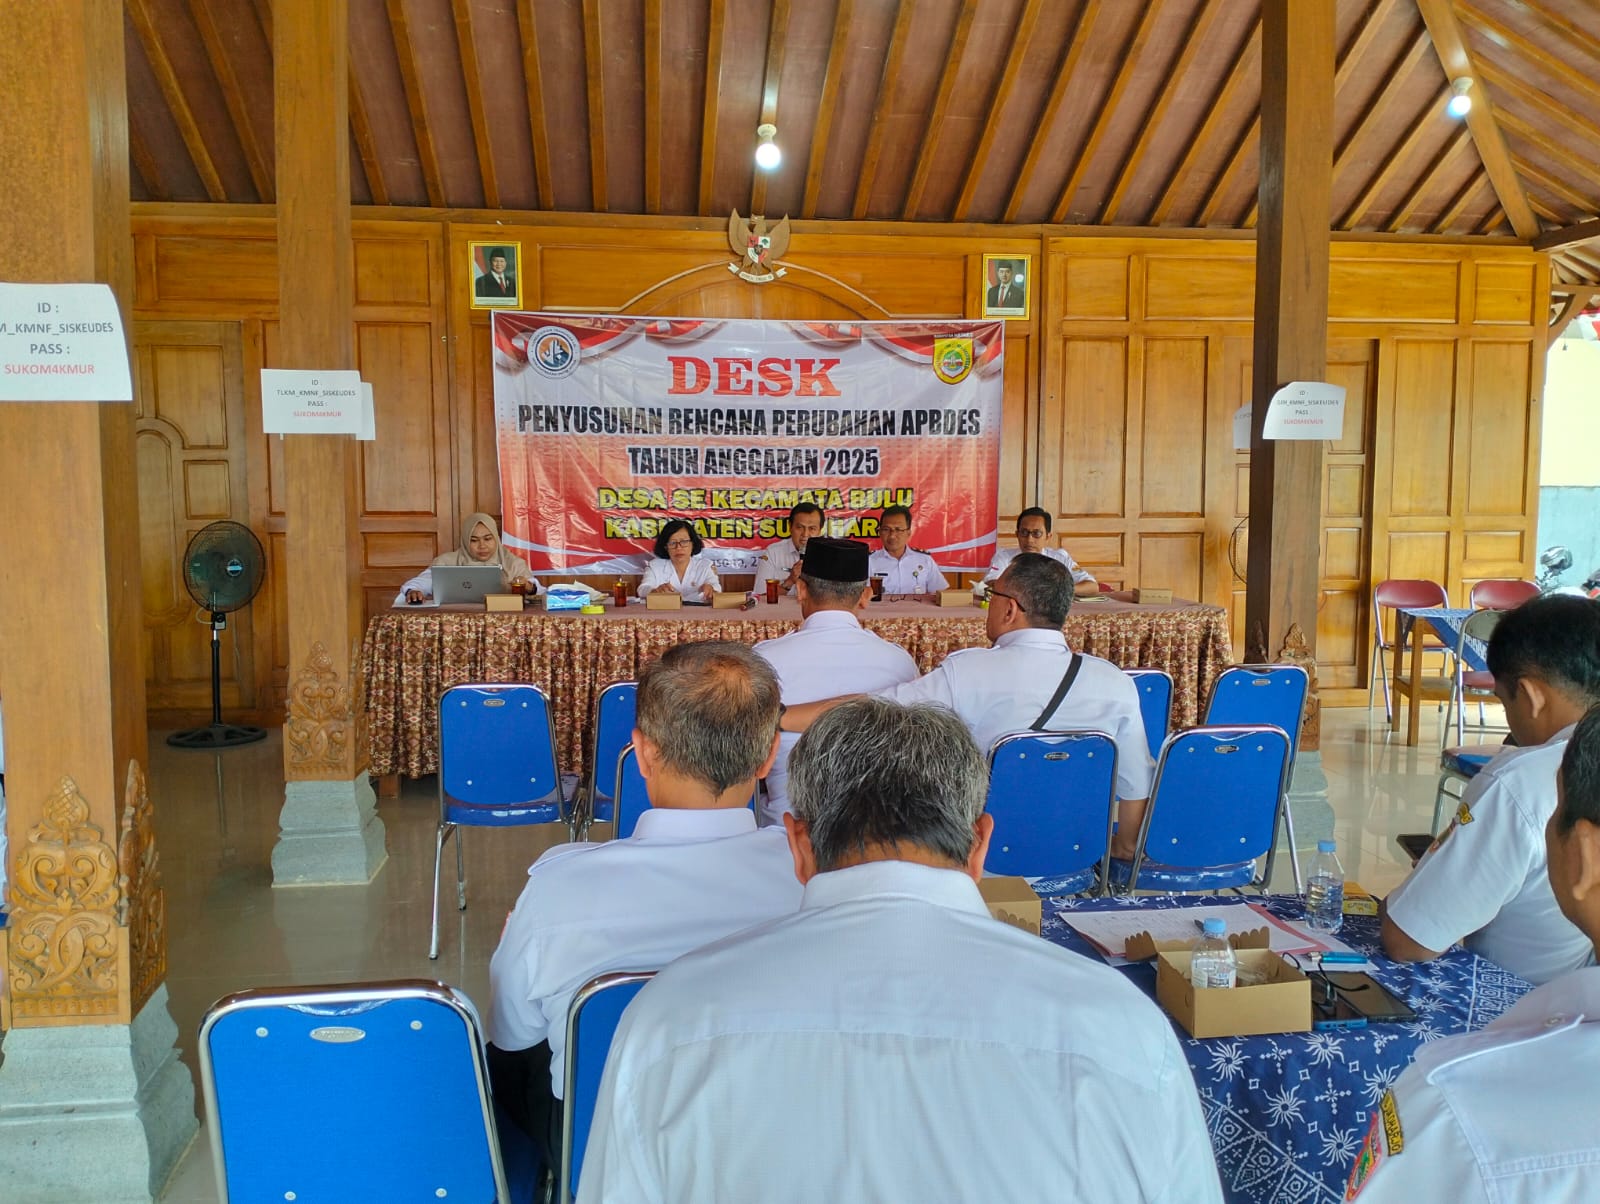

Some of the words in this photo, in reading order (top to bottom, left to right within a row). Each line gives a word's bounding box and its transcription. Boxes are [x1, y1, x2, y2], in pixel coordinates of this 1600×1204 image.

[37, 302, 51, 313] ID
[30, 343, 63, 354] PASS
[4, 364, 95, 375] SUKOM4KMUR
[667, 356, 842, 397] DESK
[518, 404, 662, 434] PENYUSUNAN
[669, 408, 767, 435] RENCANA
[772, 409, 896, 436] PERUBAHAN
[900, 408, 981, 436] APBDES
[627, 447, 699, 475] TAHUN
[703, 448, 818, 475] ANGGARAN
[823, 448, 879, 475] 2025
[598, 487, 668, 509] DESA
[672, 488, 706, 509] SE
[711, 488, 844, 509] KECAMATA
[849, 488, 914, 509] BULU
[605, 517, 753, 538] KABATEN
[758, 516, 882, 538] SUHAR
